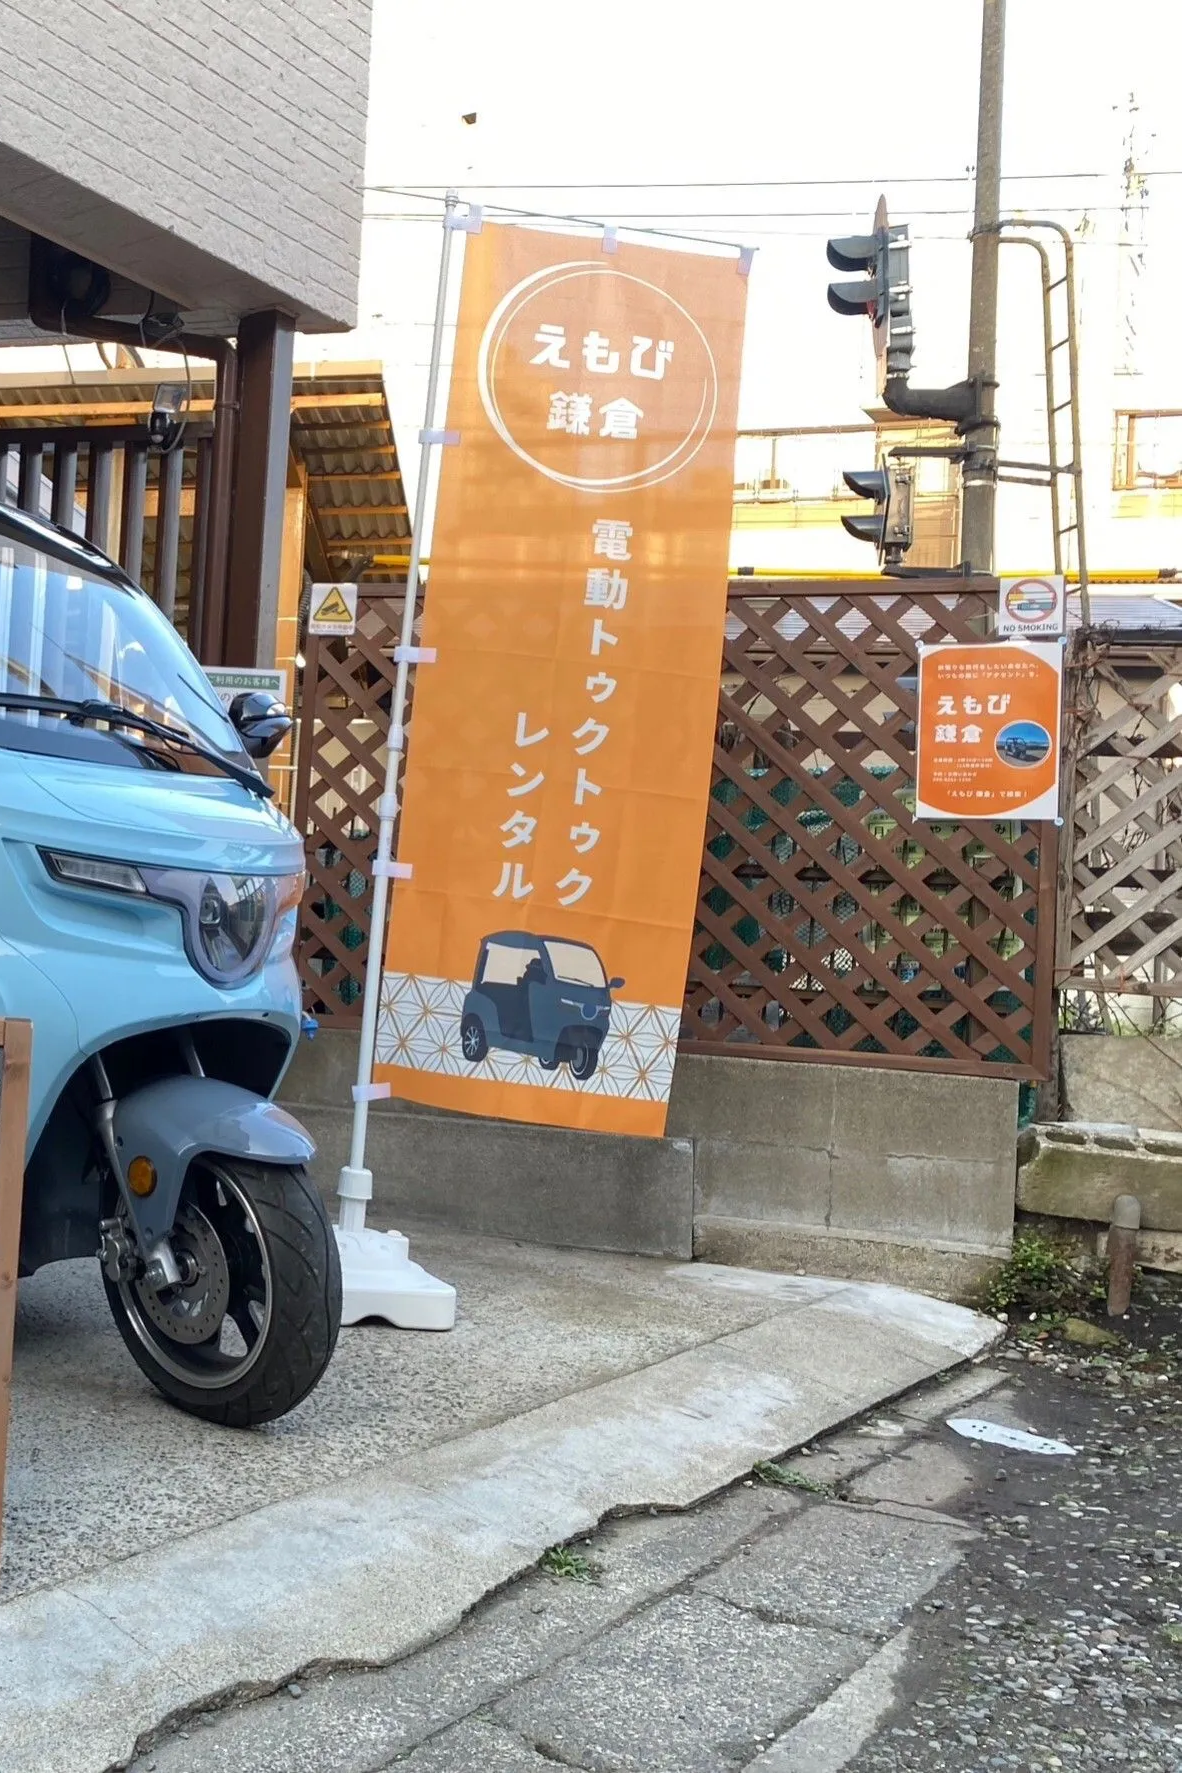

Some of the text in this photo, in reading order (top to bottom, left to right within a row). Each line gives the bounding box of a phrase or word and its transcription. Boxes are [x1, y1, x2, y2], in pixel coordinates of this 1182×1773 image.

[529, 323, 674, 380] えもび
[545, 390, 644, 440] 鎌倉
[1003, 623, 1058, 632] NO SMOKING
[555, 518, 633, 907] 電動トゥクトゥク
[936, 694, 1011, 715] えもび
[934, 724, 983, 743] 鎌倉
[492, 711, 549, 902] レンタル
